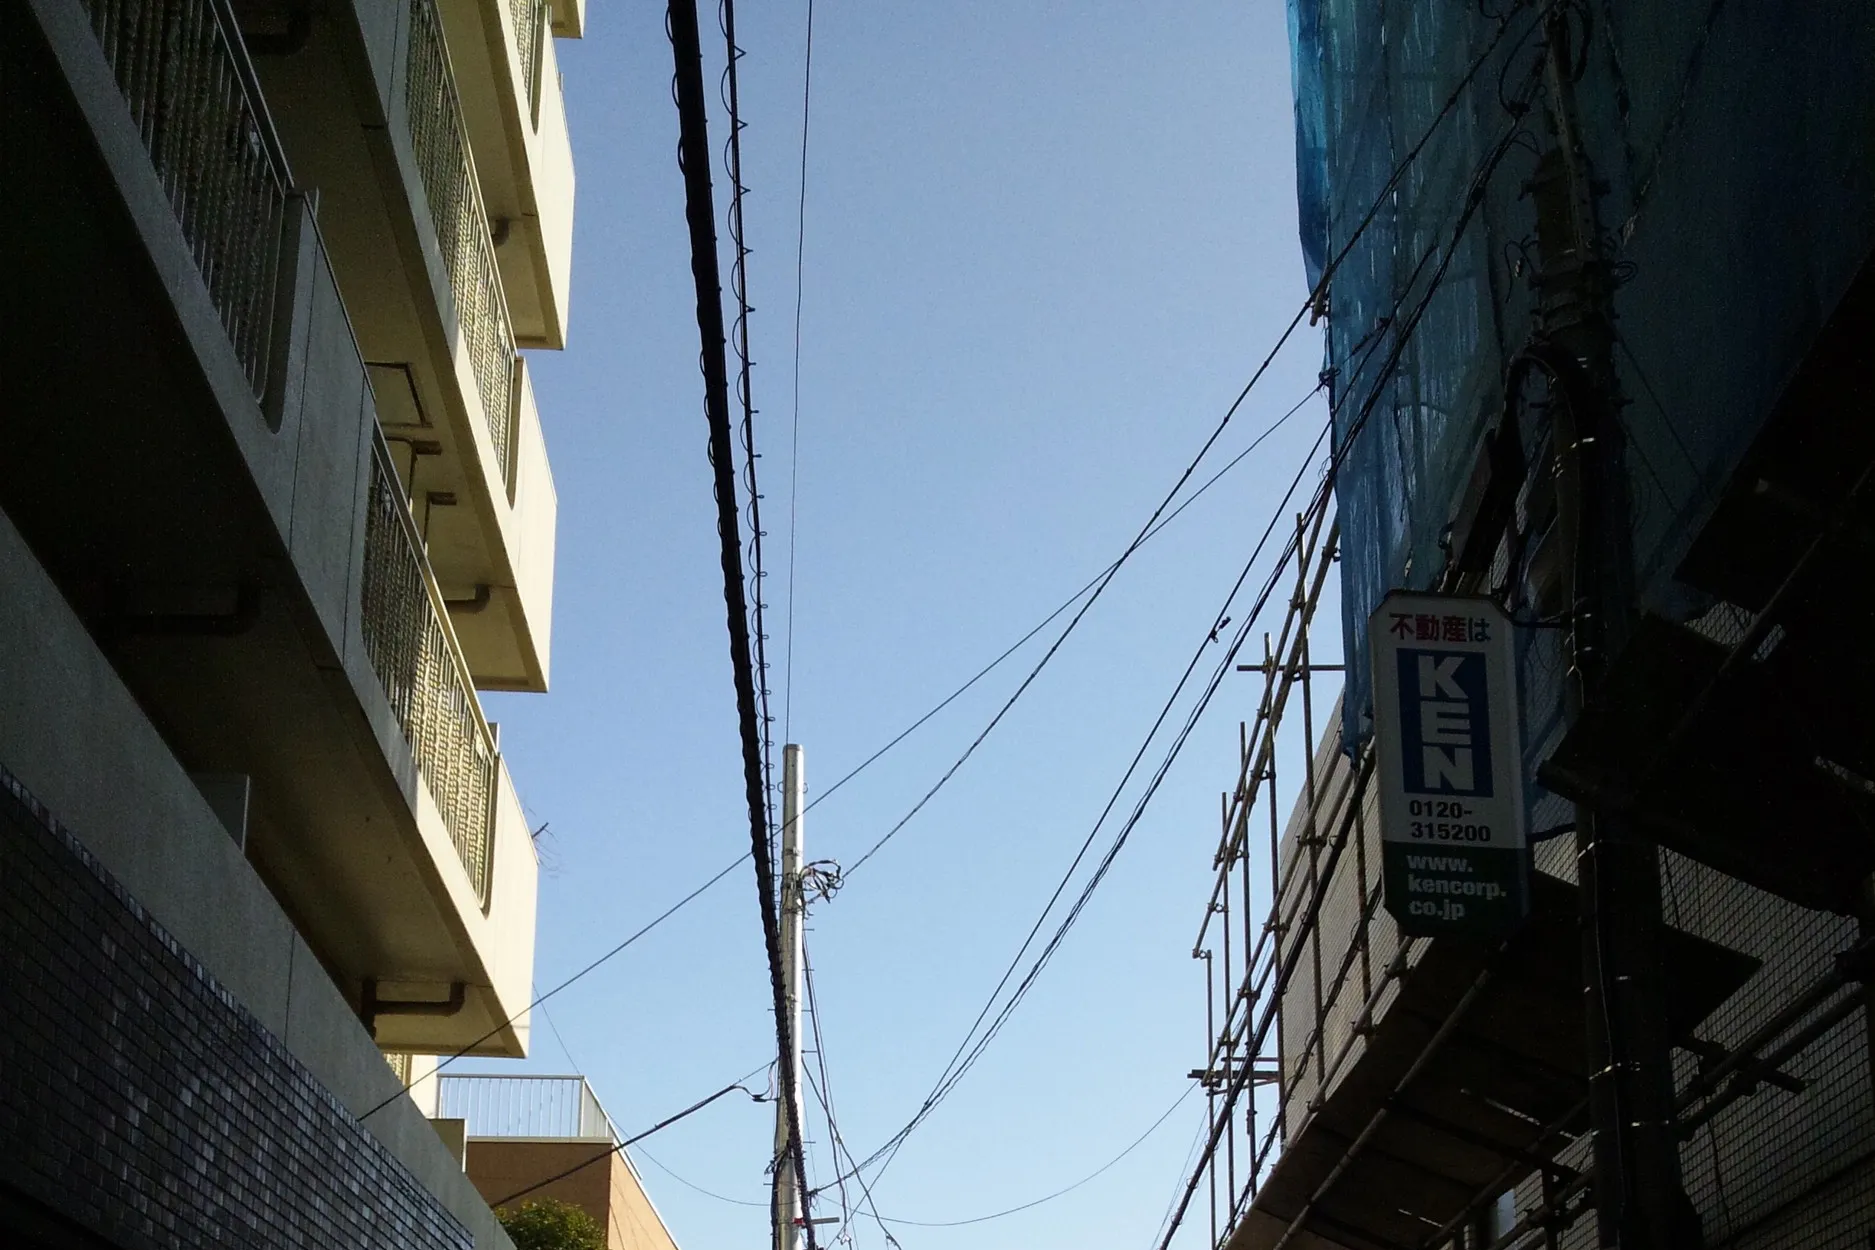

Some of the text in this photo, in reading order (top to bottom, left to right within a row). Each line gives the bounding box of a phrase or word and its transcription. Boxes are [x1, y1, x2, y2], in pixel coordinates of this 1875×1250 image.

[1389, 612, 1491, 642] 不動産は
[1418, 655, 1475, 791] KEN
[1409, 800, 1473, 819] 0120-
[1410, 821, 1491, 842] 315200
[1406, 855, 1474, 873] www.
[1408, 872, 1508, 900] kencorp.
[1408, 899, 1467, 921] co.jp
